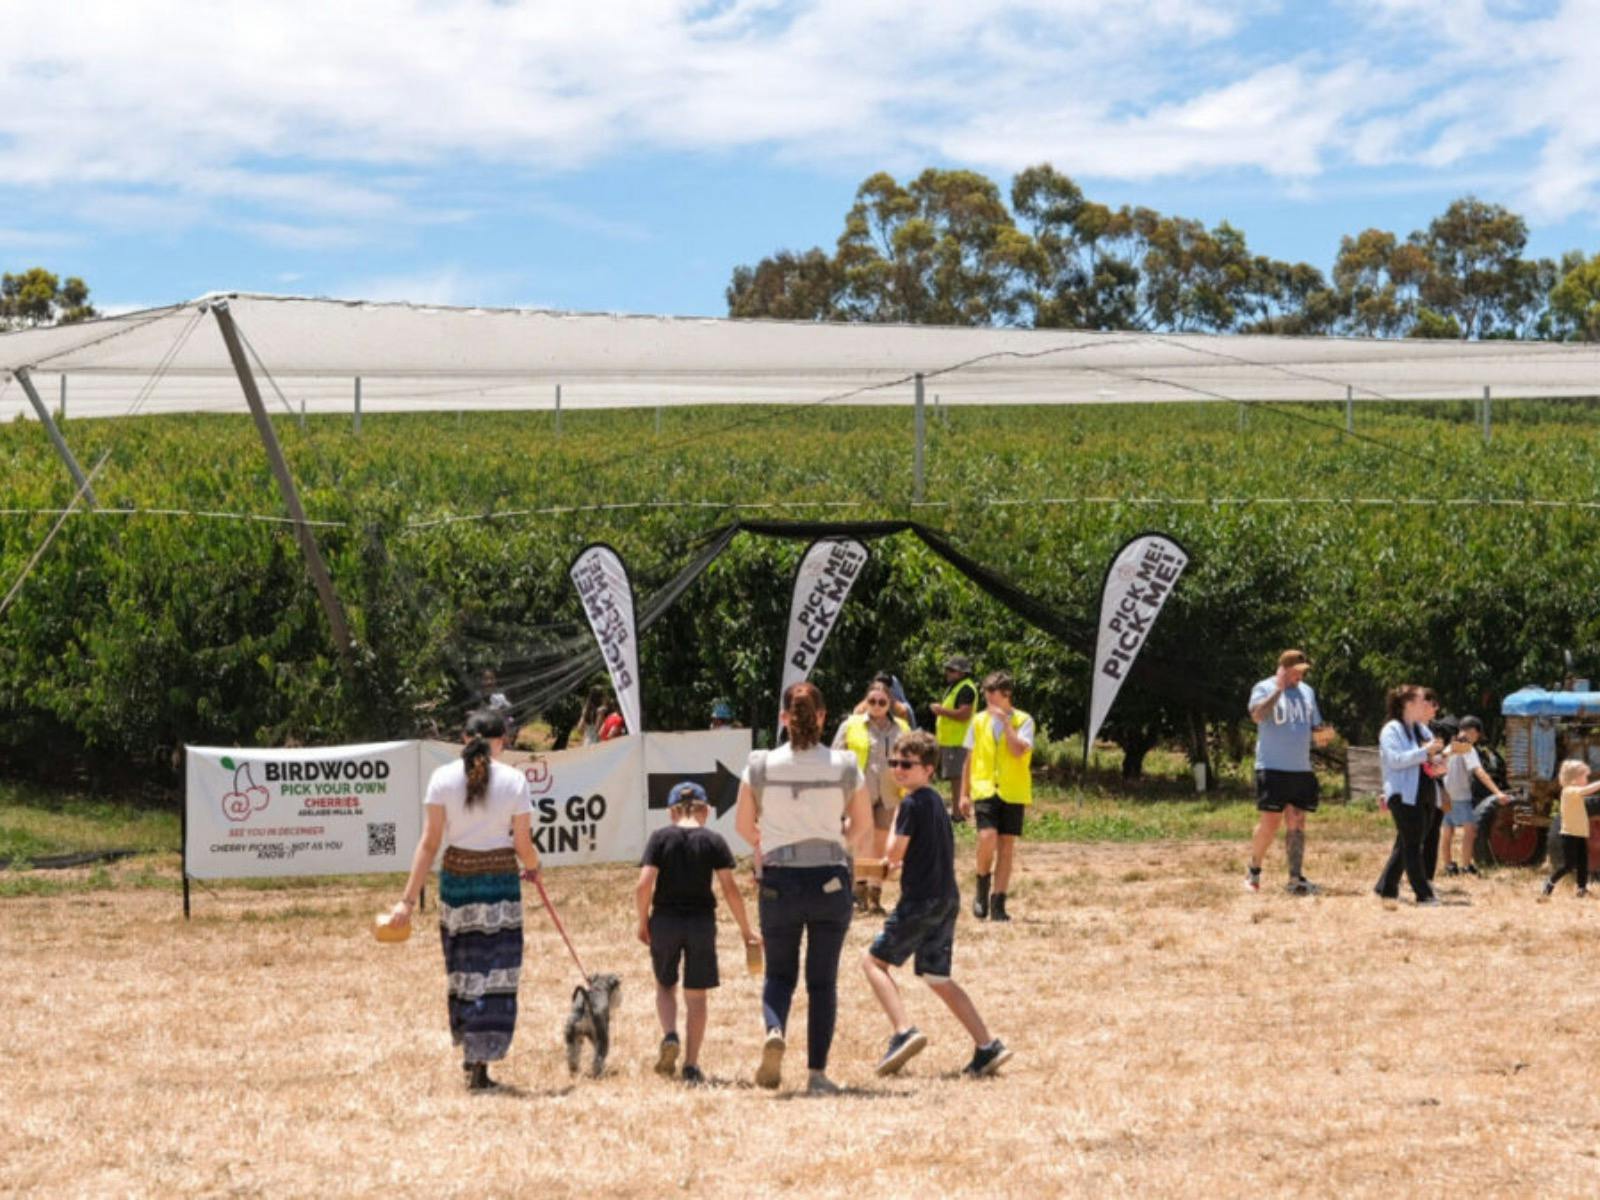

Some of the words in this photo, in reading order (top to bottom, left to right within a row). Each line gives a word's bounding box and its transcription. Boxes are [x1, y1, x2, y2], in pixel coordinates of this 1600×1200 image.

[1108, 582, 1145, 633] PICK
[1136, 542, 1165, 581] ME!
[791, 604, 836, 671] PICK
[827, 551, 863, 603] ME!
[797, 578, 831, 626] PICK
[1102, 611, 1152, 680] PICK
[1142, 554, 1183, 608] ME!
[265, 761, 390, 781] BIRDWOOD
[281, 783, 312, 796] PICK
[315, 783, 351, 795] YOUR
[354, 782, 386, 794] OWN
[303, 797, 359, 808] CHERRIES
[565, 794, 606, 822] GO
[248, 827, 266, 837] YOU
[509, 823, 596, 853] KIN'!
[210, 843, 246, 852] CHERRY
[248, 842, 284, 851] PICKING
[324, 841, 343, 850] YOU
